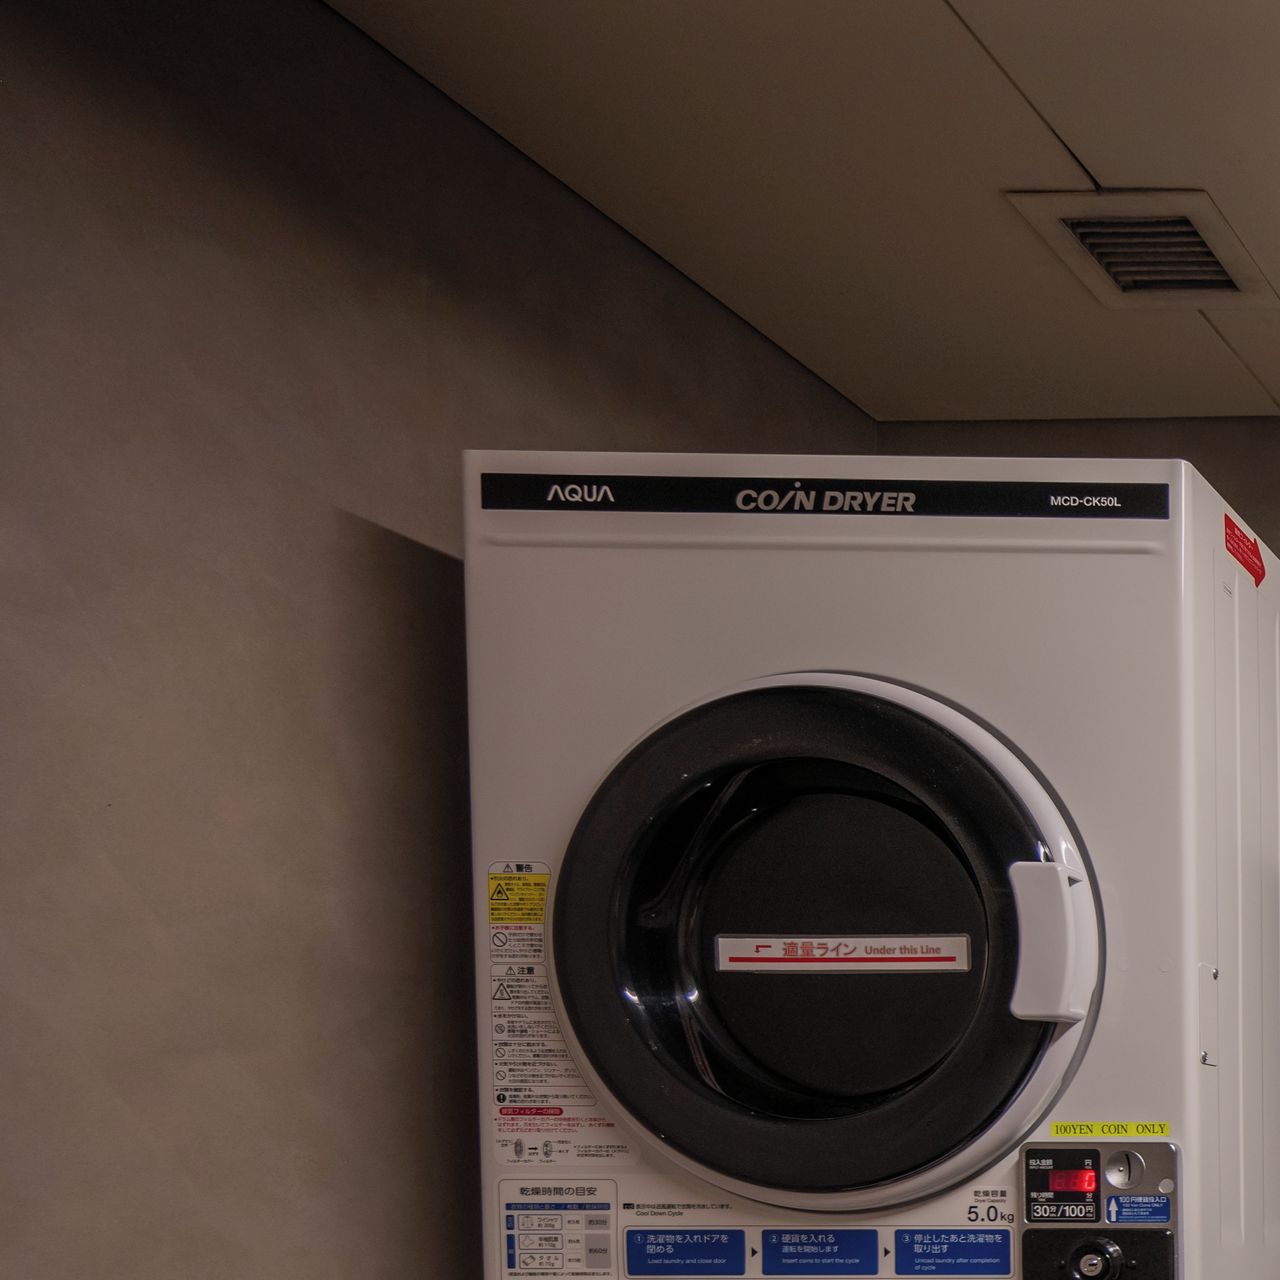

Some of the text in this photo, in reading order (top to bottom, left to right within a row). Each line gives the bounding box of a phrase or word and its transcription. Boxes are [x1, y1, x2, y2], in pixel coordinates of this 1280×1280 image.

[547, 485, 614, 502] AQUA
[736, 482, 918, 514] COIN DRYER
[1051, 496, 1121, 506] MCD-CK50L
[515, 863, 534, 874] 警告
[782, 940, 943, 958] 適量ライン Under this Line
[516, 967, 534, 976] 注意
[1056, 1124, 1165, 1134] 100YEN COIN ONLY
[520, 1185, 599, 1198] 乾燥時間の目安
